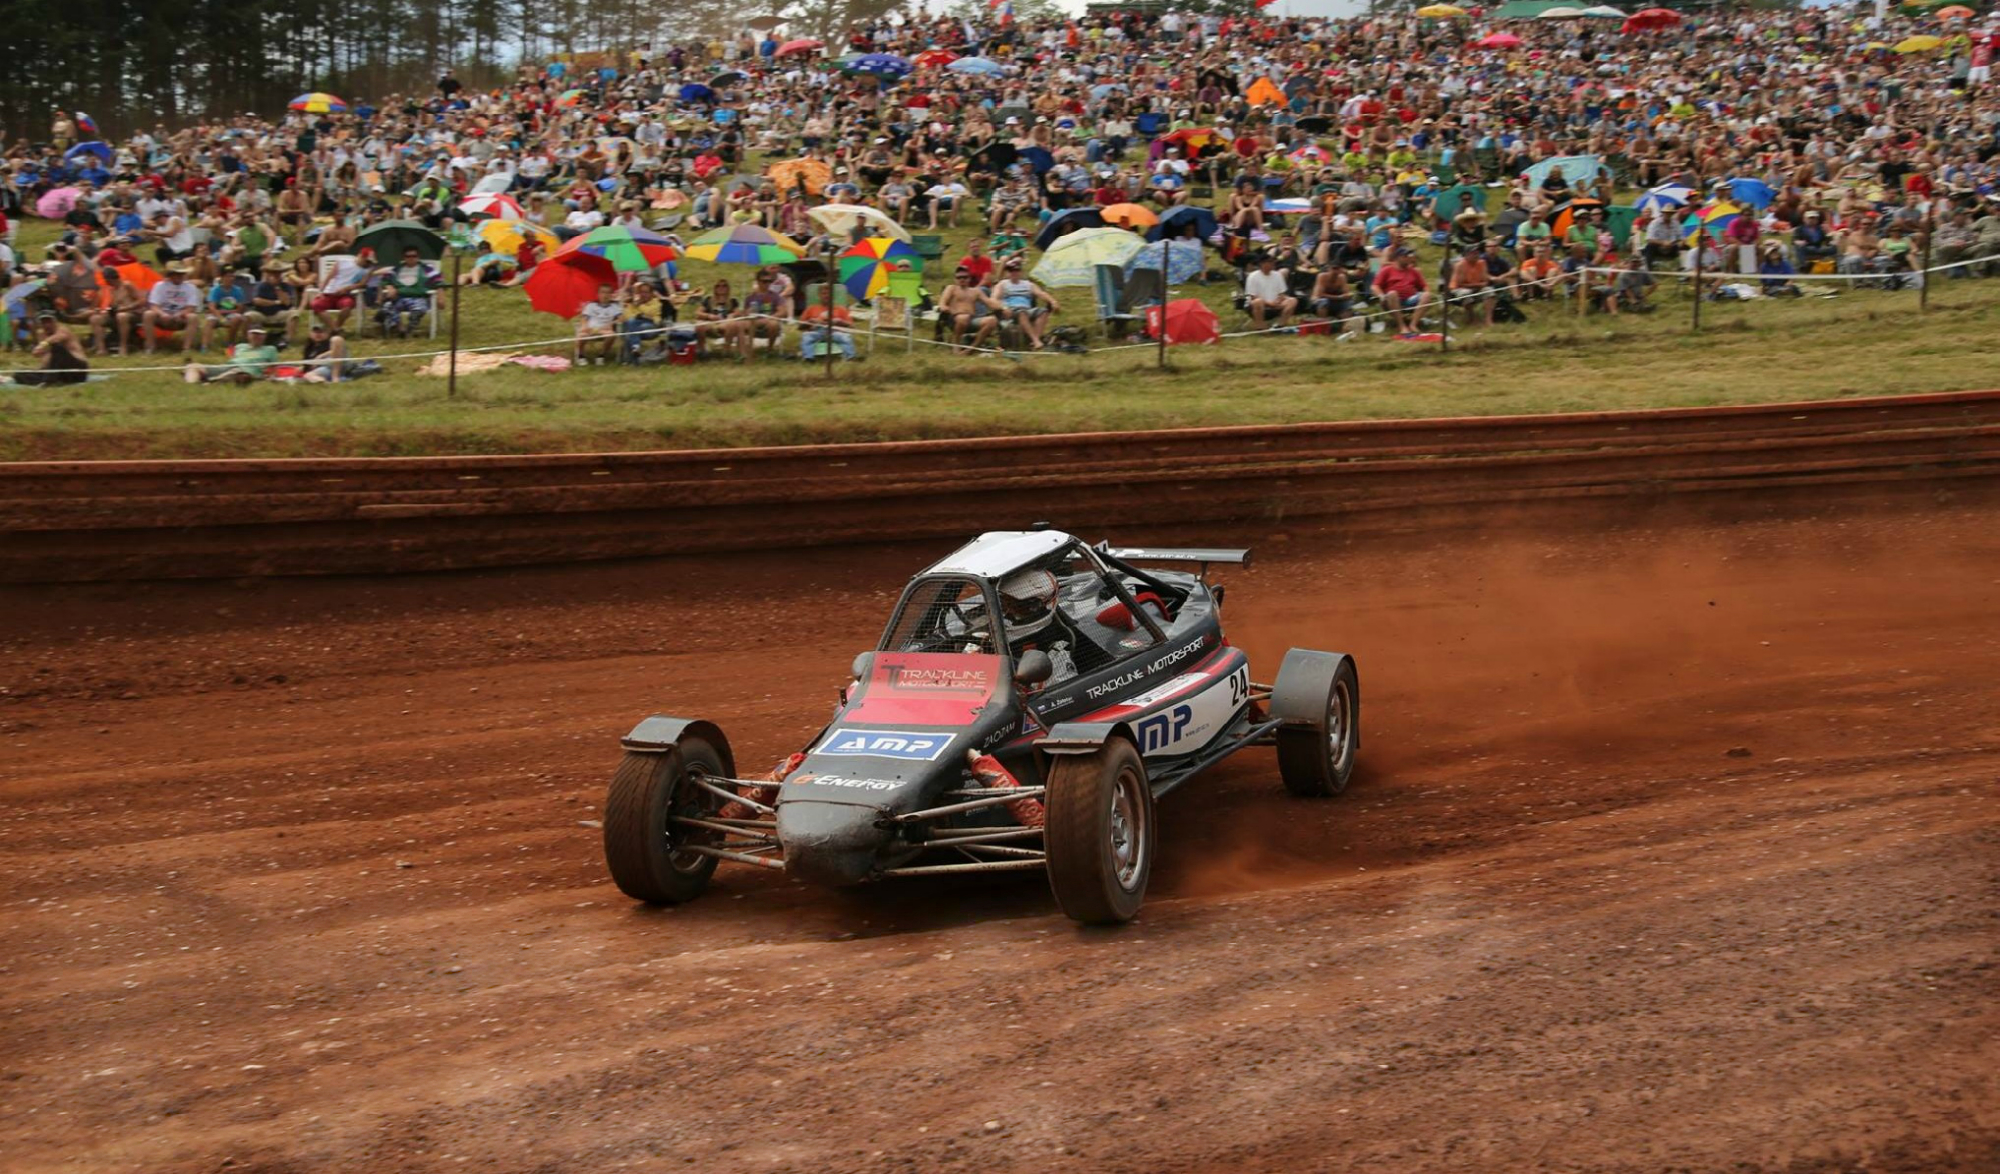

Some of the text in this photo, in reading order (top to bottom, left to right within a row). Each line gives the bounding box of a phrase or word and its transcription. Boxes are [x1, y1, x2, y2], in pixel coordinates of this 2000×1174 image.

[901, 669, 987, 681] TRACKLINE
[1086, 669, 1144, 699] TRACKLINE
[1147, 636, 1204, 675] MOTORSPORT
[1230, 669, 1248, 706] 24
[836, 737, 935, 753] AMP
[1138, 704, 1192, 751] MP
